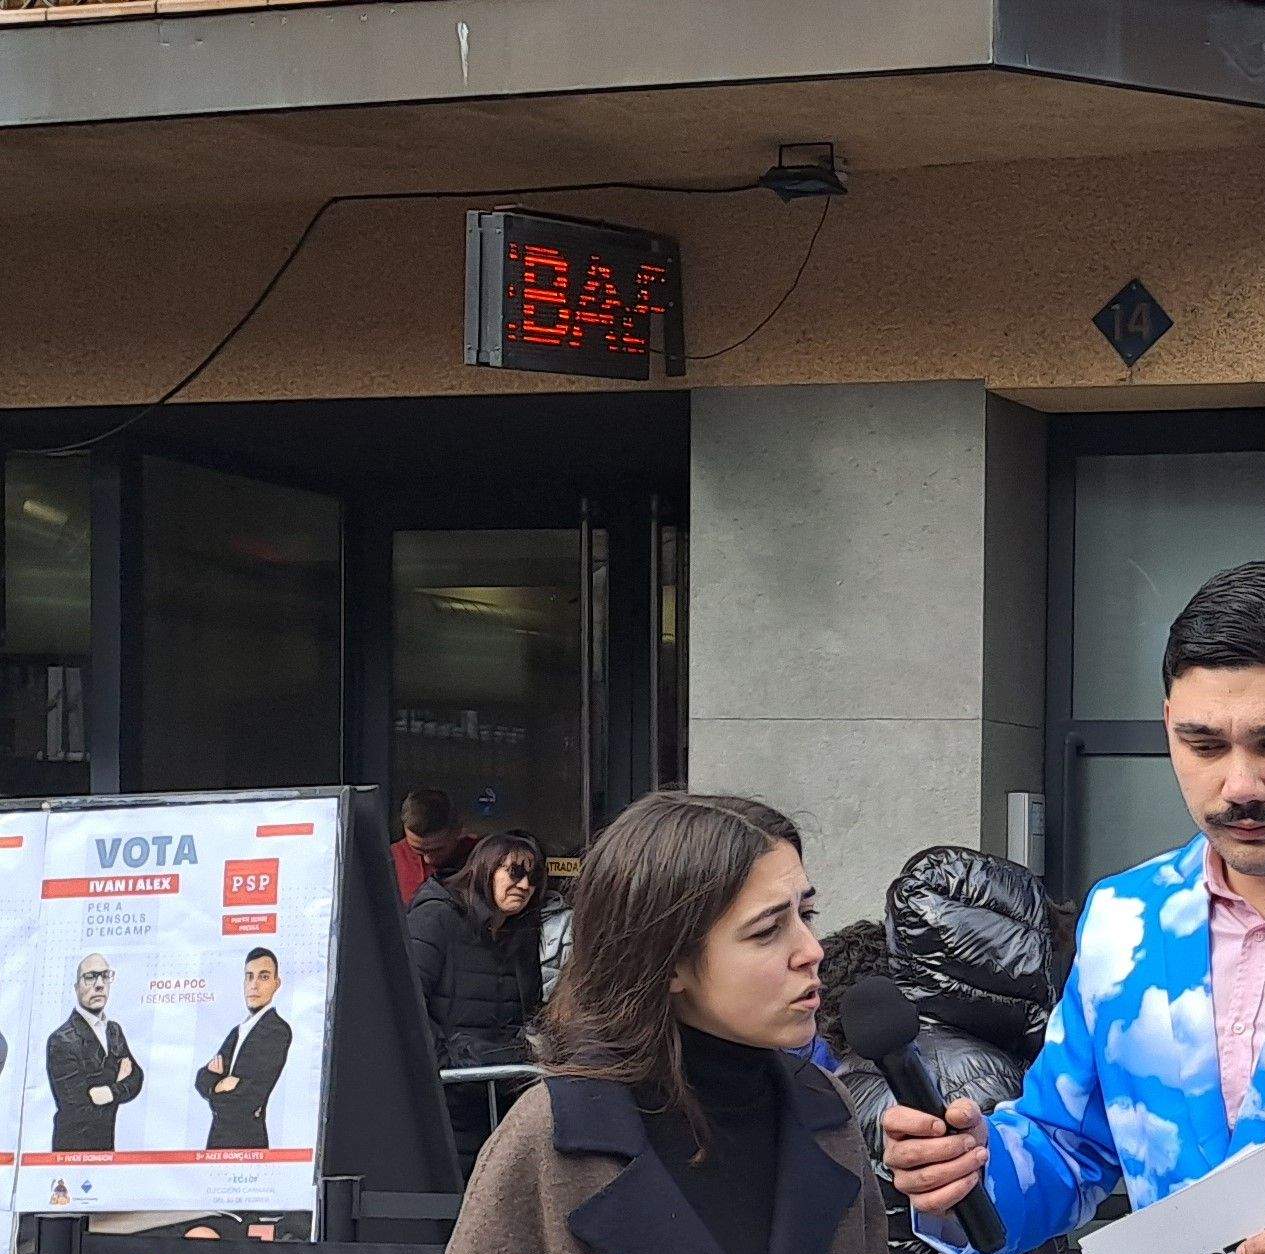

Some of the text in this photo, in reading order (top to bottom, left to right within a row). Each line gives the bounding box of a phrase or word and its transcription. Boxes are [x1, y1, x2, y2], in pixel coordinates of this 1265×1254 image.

[1111, 303, 1149, 341] 14
[95, 834, 199, 869] VOTA
[89, 879, 126, 893] IVAN
[135, 876, 172, 891] ALEX
[231, 874, 270, 892] PSP
[88, 901, 122, 912] PER A
[87, 913, 147, 925] CONSOLS
[86, 925, 152, 937] D'ENCAMP
[149, 980, 171, 990] POC
[184, 979, 207, 989] POC
